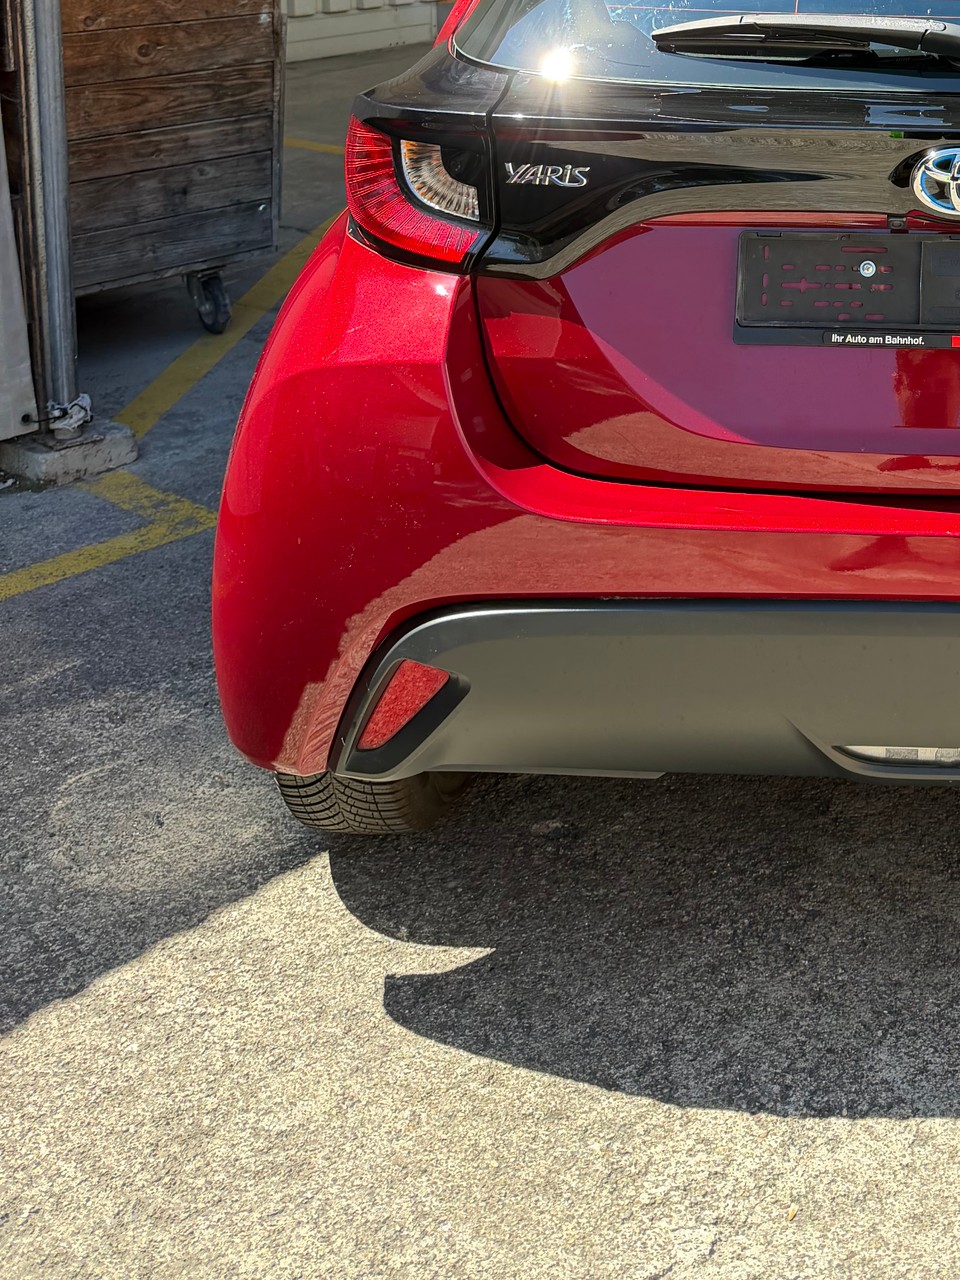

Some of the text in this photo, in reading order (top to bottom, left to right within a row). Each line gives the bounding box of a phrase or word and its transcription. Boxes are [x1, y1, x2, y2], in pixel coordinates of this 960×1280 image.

[831, 333, 925, 346] Ihr Auto am Bahnhof.
